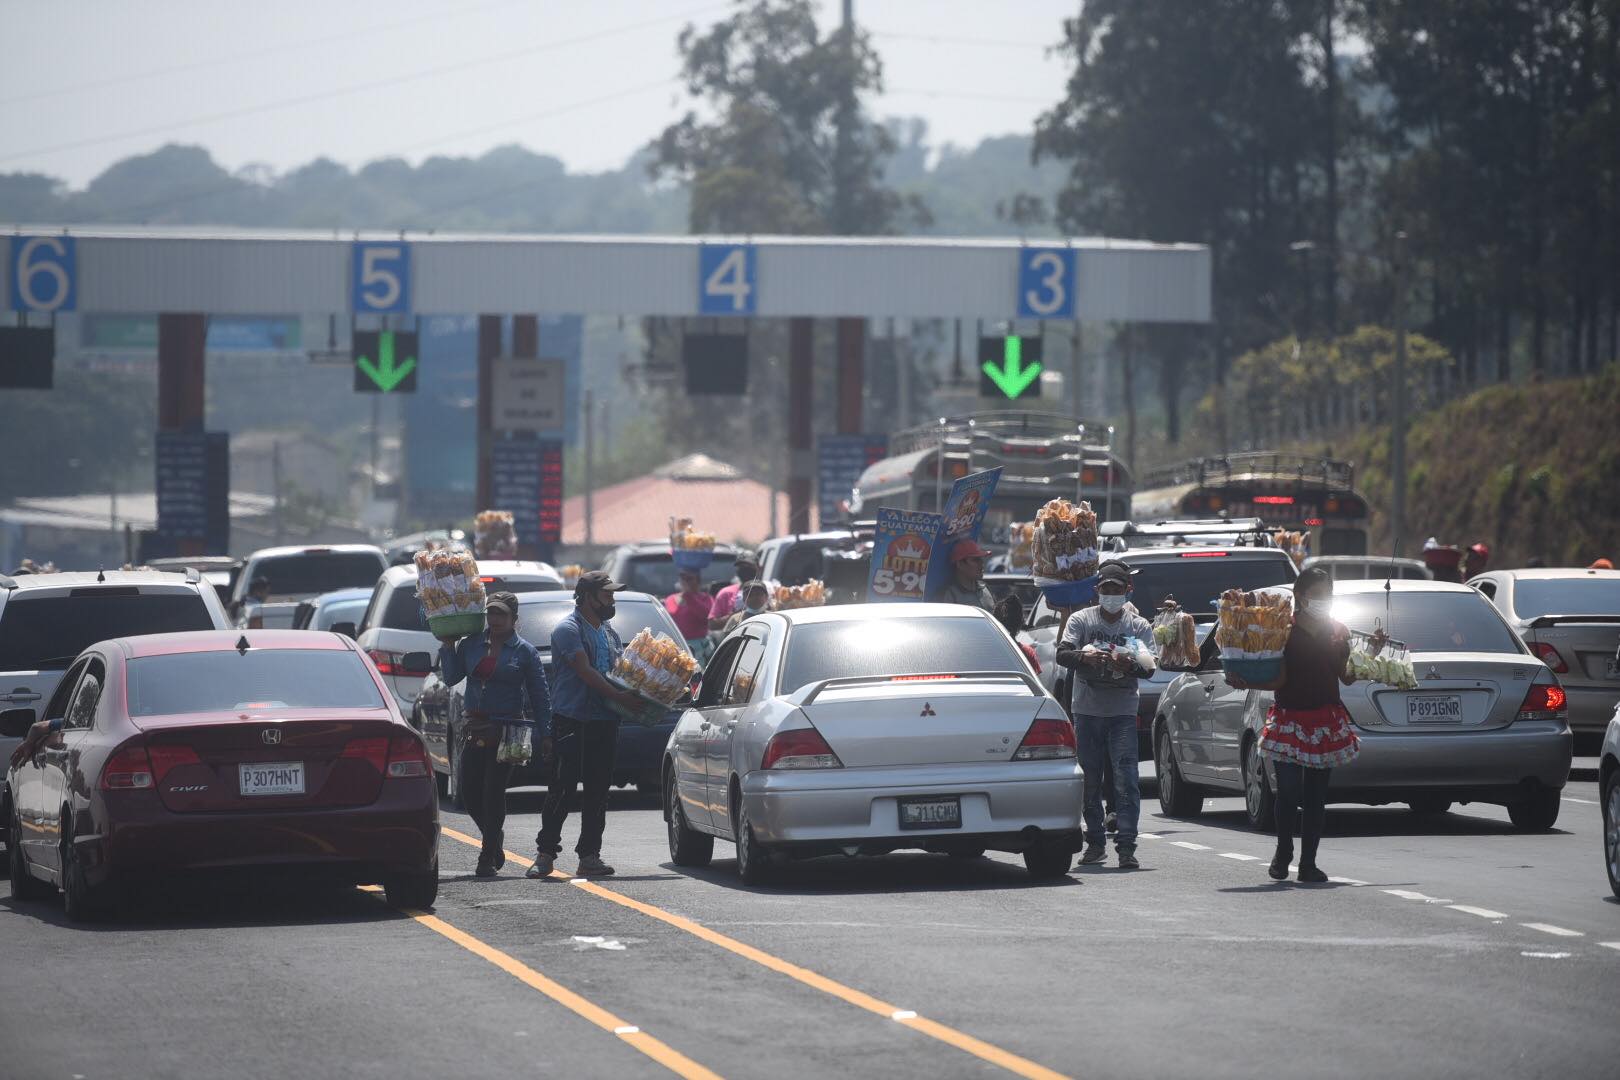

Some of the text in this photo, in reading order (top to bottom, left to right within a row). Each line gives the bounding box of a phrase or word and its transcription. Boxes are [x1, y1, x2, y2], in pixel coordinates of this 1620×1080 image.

[18, 238, 69, 310] 6
[362, 247, 400, 308] 5
[706, 249, 750, 310] 4
[1027, 252, 1065, 313] 3
[880, 520, 937, 533] GUATEMAL
